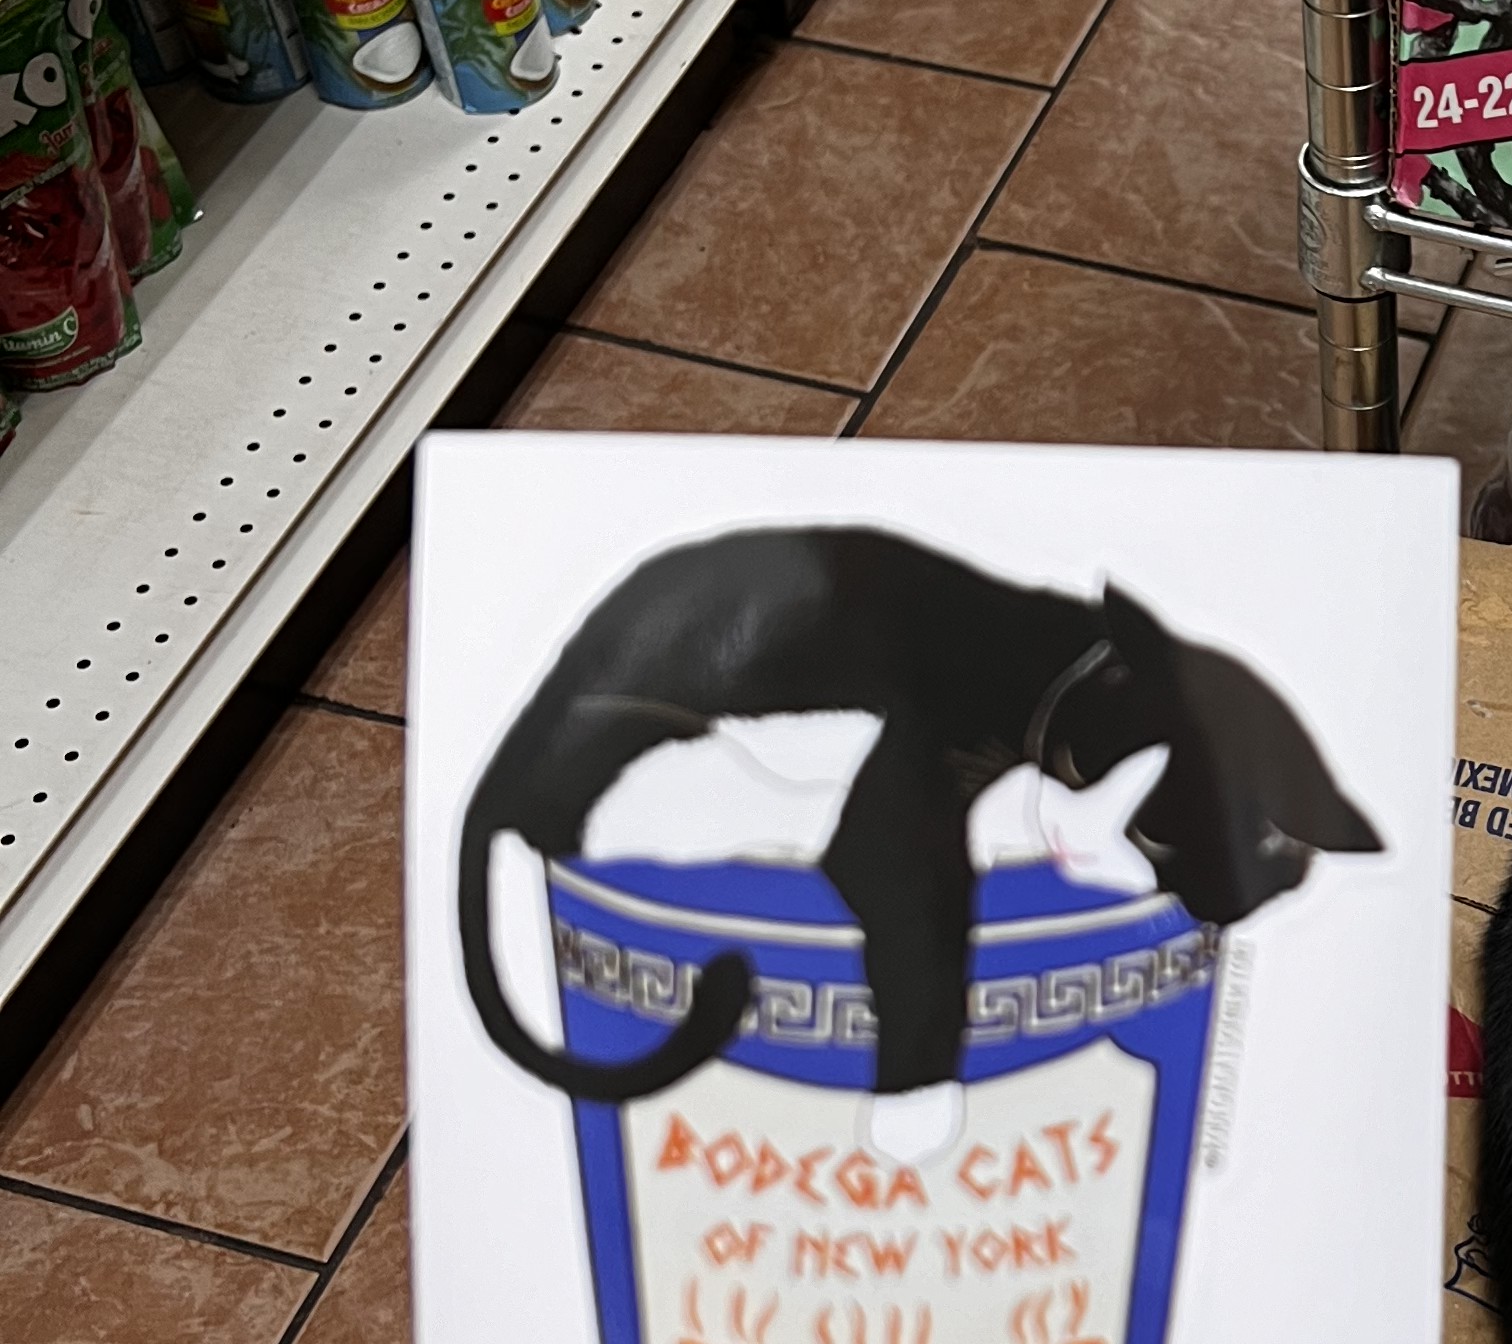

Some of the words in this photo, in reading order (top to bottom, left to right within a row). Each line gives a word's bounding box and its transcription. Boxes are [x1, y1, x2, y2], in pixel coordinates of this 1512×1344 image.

[656, 1110, 930, 1211] BODEGA
[956, 1109, 1120, 1203] CATS
[700, 1219, 774, 1268] OF
[789, 1227, 919, 1280] NEW
[938, 1216, 1077, 1278] YORK
